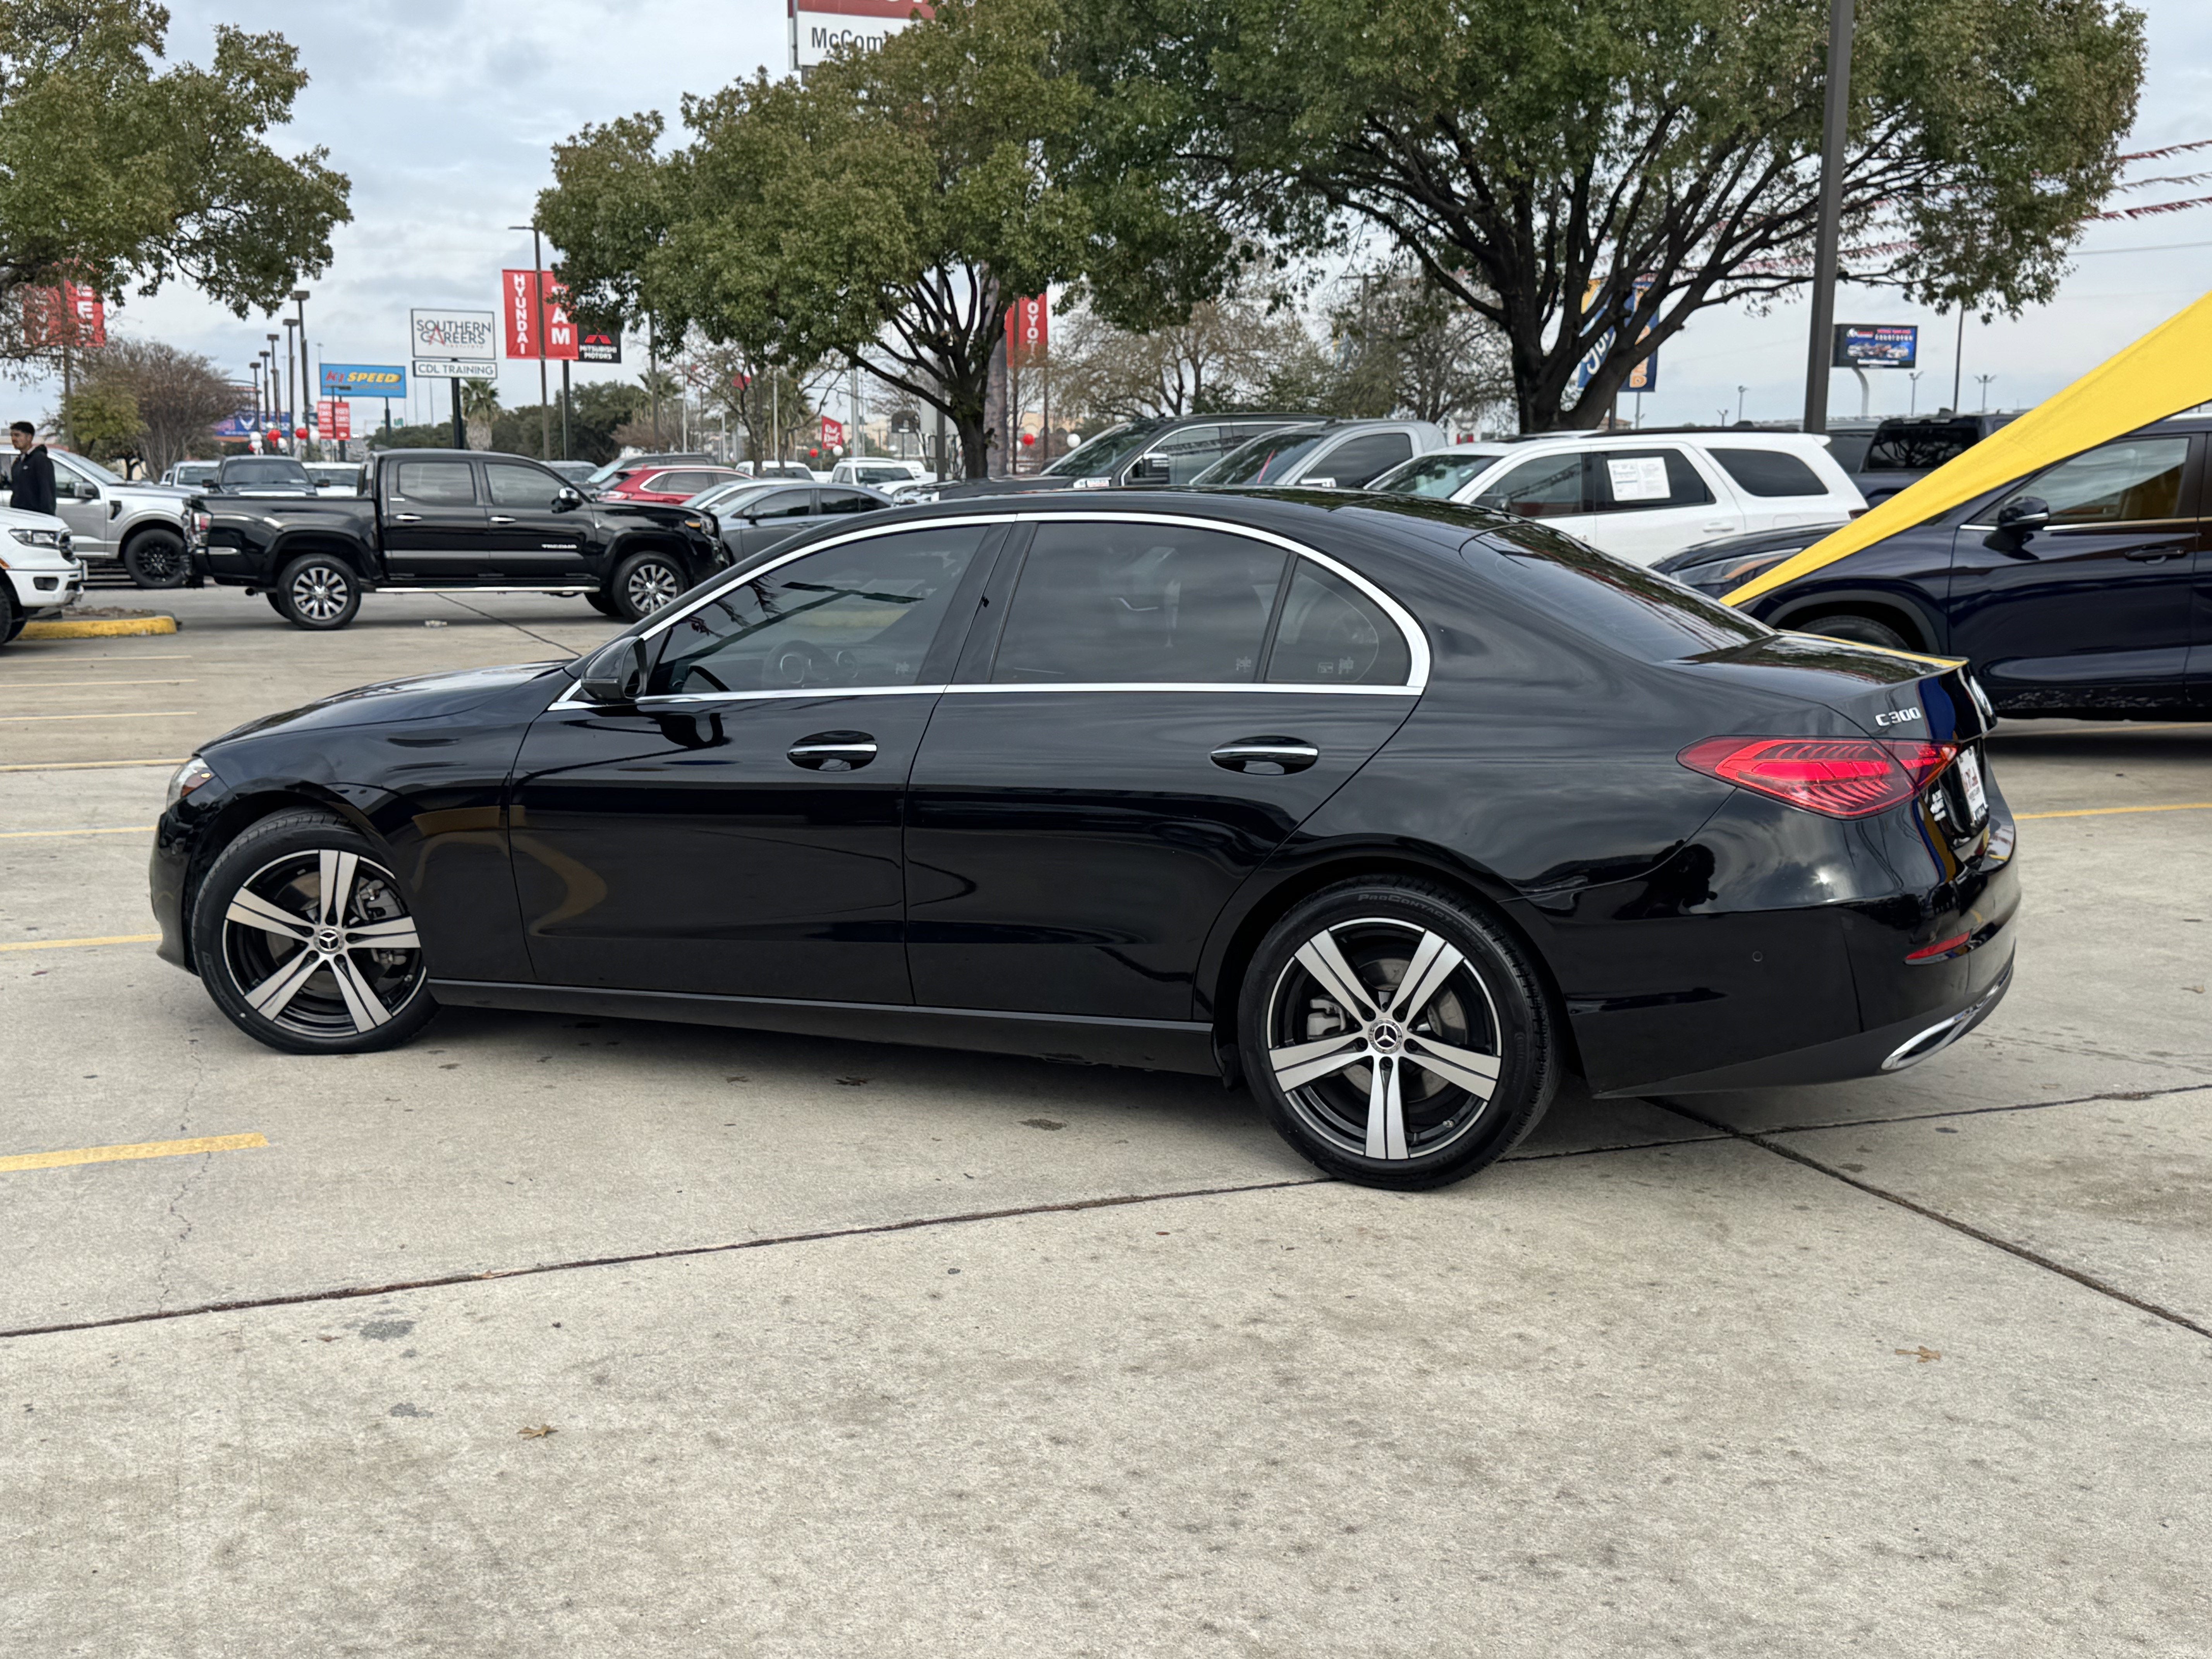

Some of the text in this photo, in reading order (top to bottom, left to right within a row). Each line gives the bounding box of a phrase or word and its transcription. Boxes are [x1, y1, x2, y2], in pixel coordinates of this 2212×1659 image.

[513, 273, 529, 355] HYUNDAI
[416, 319, 492, 336] SOUTHERN
[420, 325, 486, 346] CAREERS
[1027, 301, 1039, 365] OYOT
[347, 372, 402, 383] SPEED
[418, 364, 493, 375] CDL TRAINING
